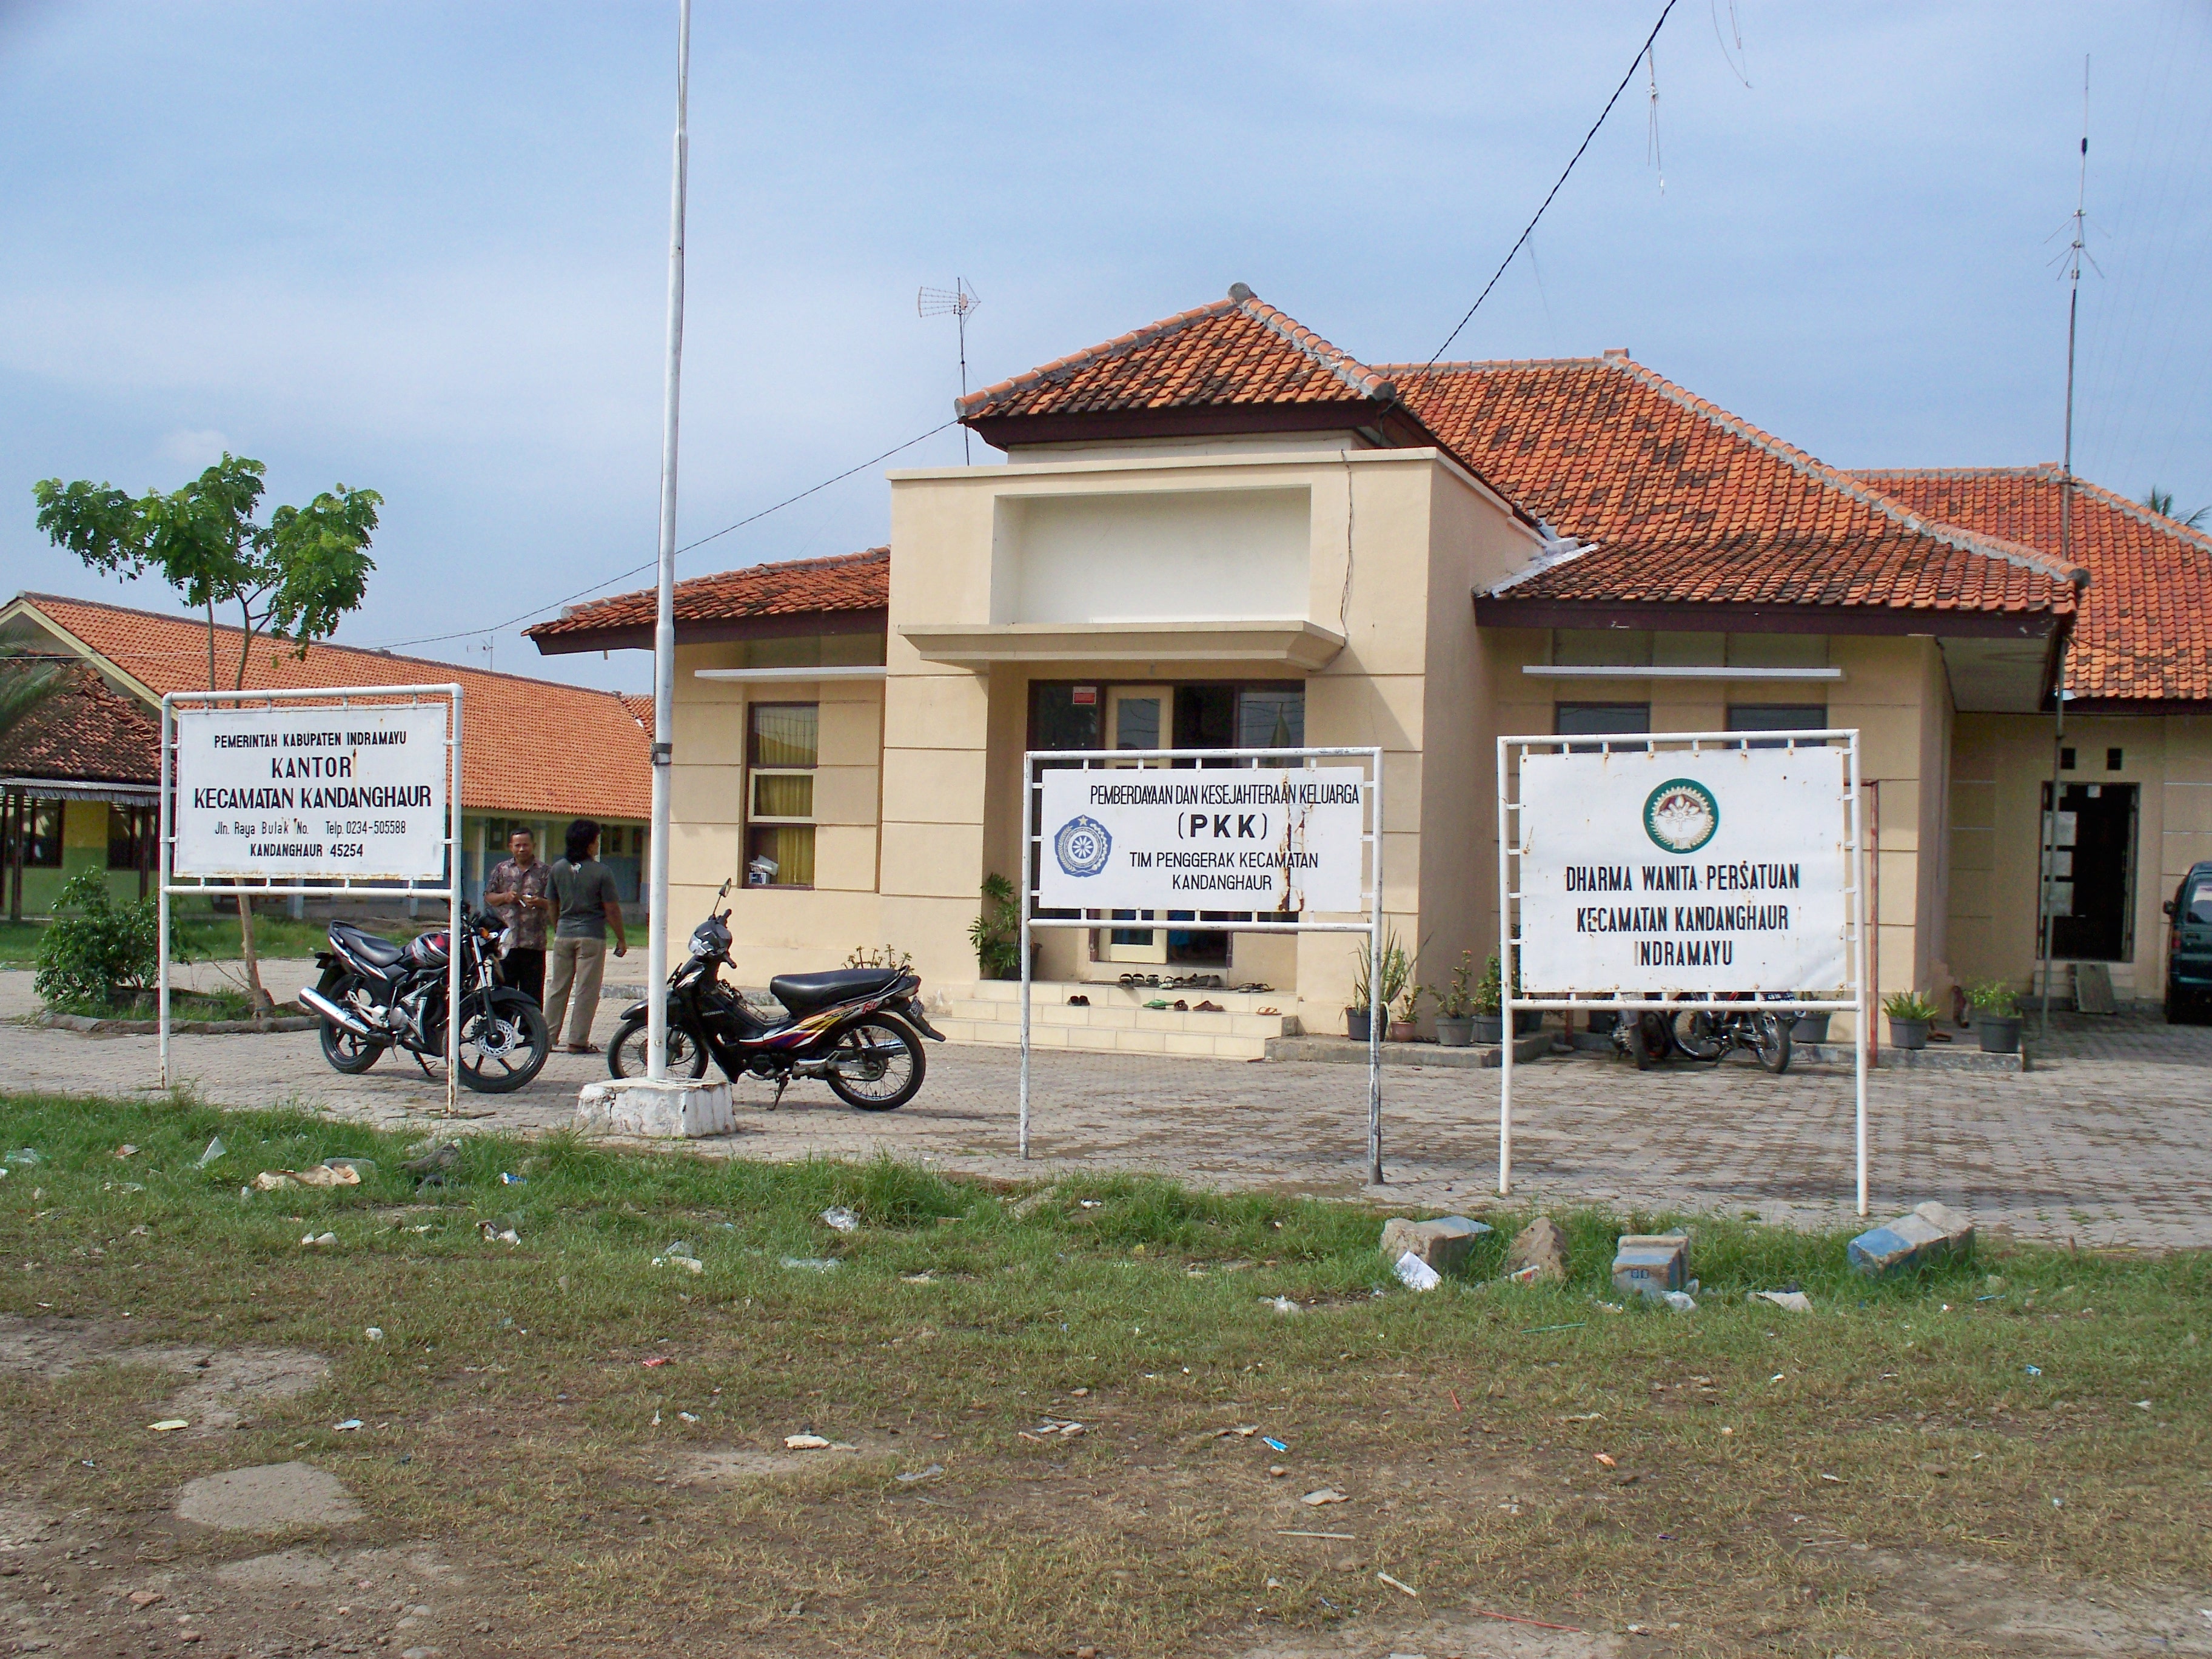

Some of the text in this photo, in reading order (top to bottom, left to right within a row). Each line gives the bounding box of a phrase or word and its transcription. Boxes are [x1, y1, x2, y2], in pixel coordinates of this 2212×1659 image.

[215, 731, 406, 748] PEMERINTAH KABUPATEN INDRAMAYU
[272, 757, 351, 778] KANTOR
[195, 786, 431, 808] KECAMATAN KANDANGHAUR
[1091, 785, 1359, 805] PEMBERDAYAAN DAN KESEJAHTERAAN KELUARGA
[235, 822, 255, 837] Raya
[262, 821, 289, 834] Bulak
[297, 822, 309, 834] No.
[347, 820, 405, 834] 0234-505588
[250, 844, 363, 857] KANDANGHAUR 45254
[1130, 852, 1318, 868] TIM PENGGERAK KECAMATAN
[1173, 875, 1271, 890] KANDANGHAUR
[1567, 864, 1798, 891] DHARMA WANITA PERSATUAN
[1578, 905, 1788, 932] KECAMATAN KANDANGHAUR
